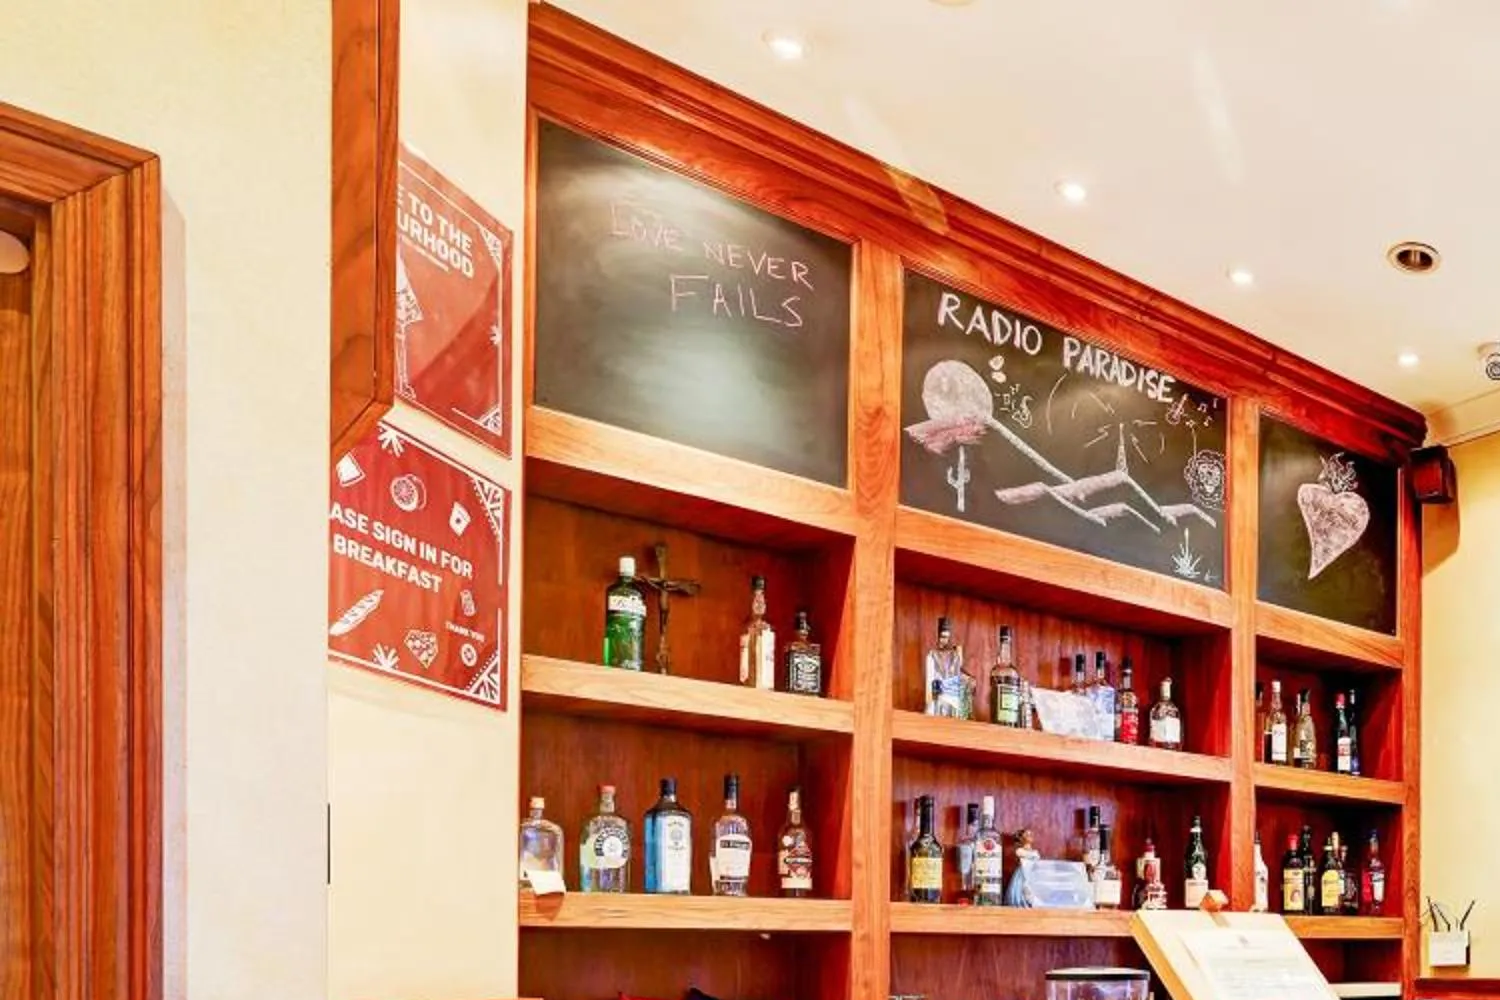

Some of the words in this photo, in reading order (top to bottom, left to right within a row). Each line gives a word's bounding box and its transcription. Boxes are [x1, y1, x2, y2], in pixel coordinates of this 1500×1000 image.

[397, 207, 474, 279] URHOOD
[408, 191, 433, 227] TO
[436, 213, 473, 258] THE
[609, 202, 685, 252] LOVE
[702, 241, 815, 292] NEVER
[669, 274, 803, 328] FAILS
[937, 291, 1043, 356] RADIO
[1062, 336, 1177, 404] PARADISE
[333, 533, 443, 593] BREAKFAST
[372, 520, 416, 556] SIGN
[419, 541, 437, 565] IN
[441, 549, 473, 580] FOR
